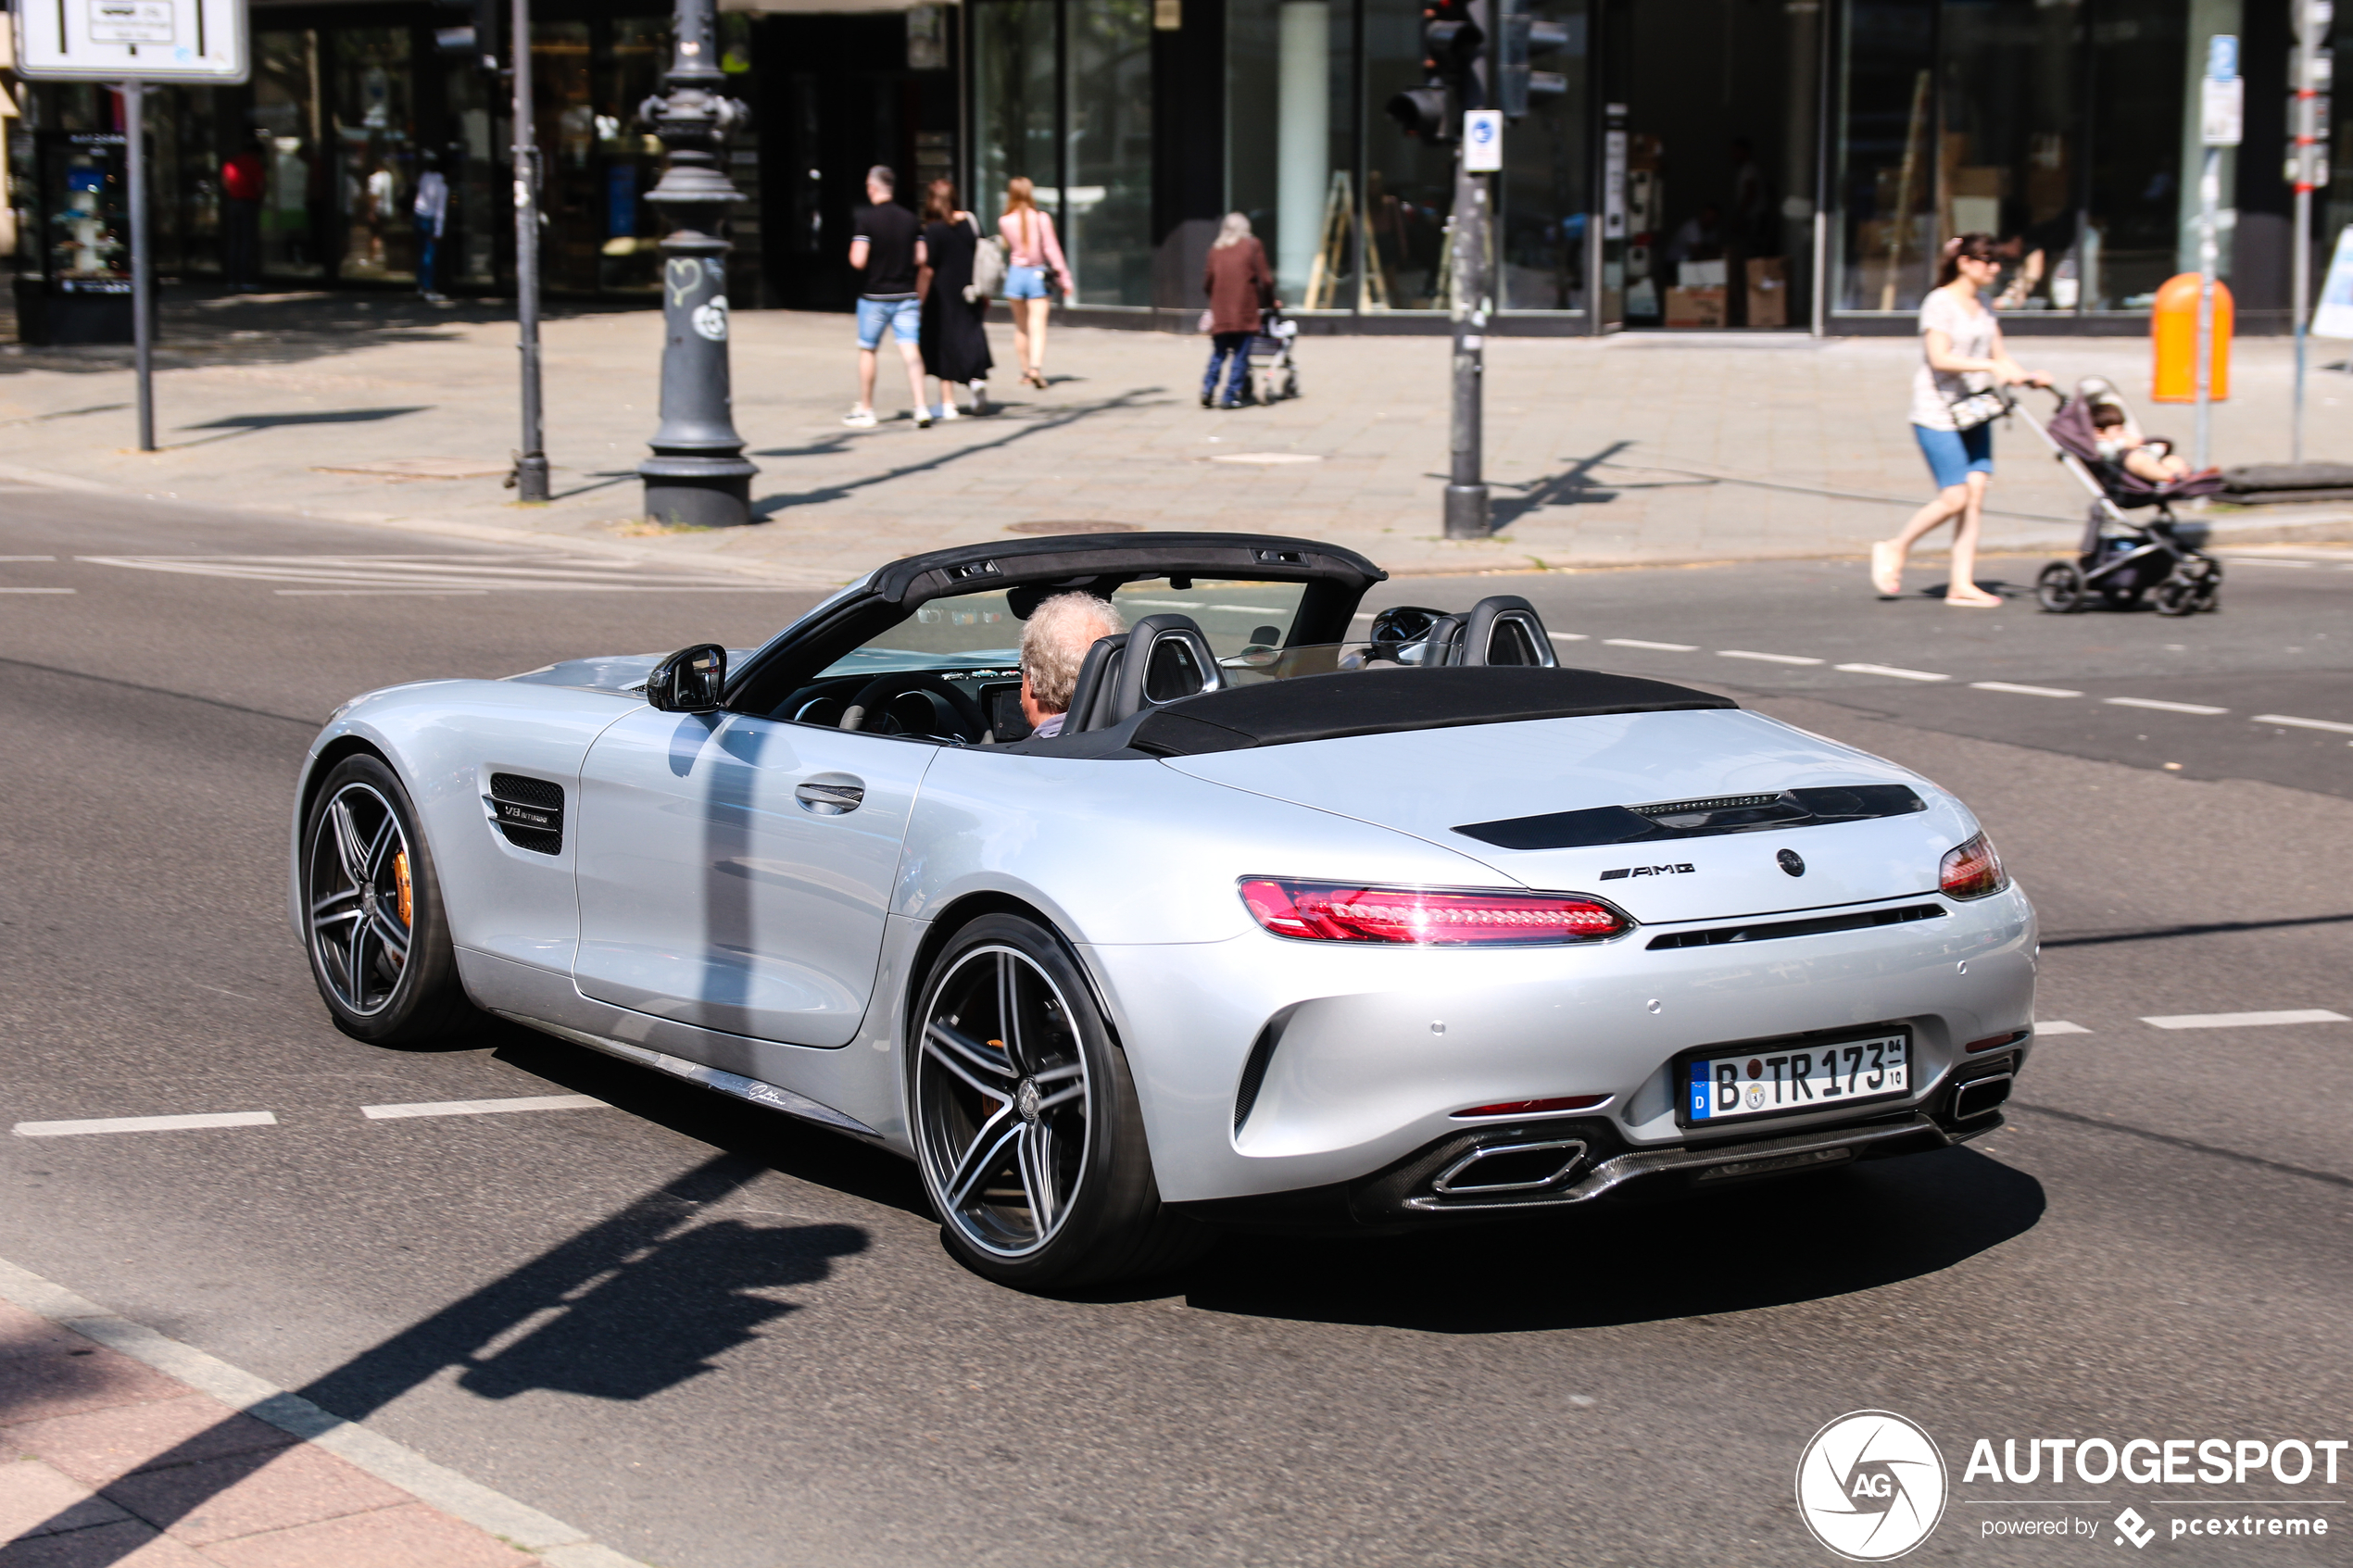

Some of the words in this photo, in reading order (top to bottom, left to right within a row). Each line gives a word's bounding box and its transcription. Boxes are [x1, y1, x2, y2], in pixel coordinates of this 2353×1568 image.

[505, 805, 521, 817] V8
[1631, 863, 1695, 878] AMG
[1888, 1038, 1902, 1053] 04
[1695, 1096, 1705, 1110] D
[1717, 1063, 1740, 1111] B
[1767, 1053, 1813, 1104] TR
[1822, 1042, 1885, 1097] 173
[1890, 1071, 1902, 1085] 10
